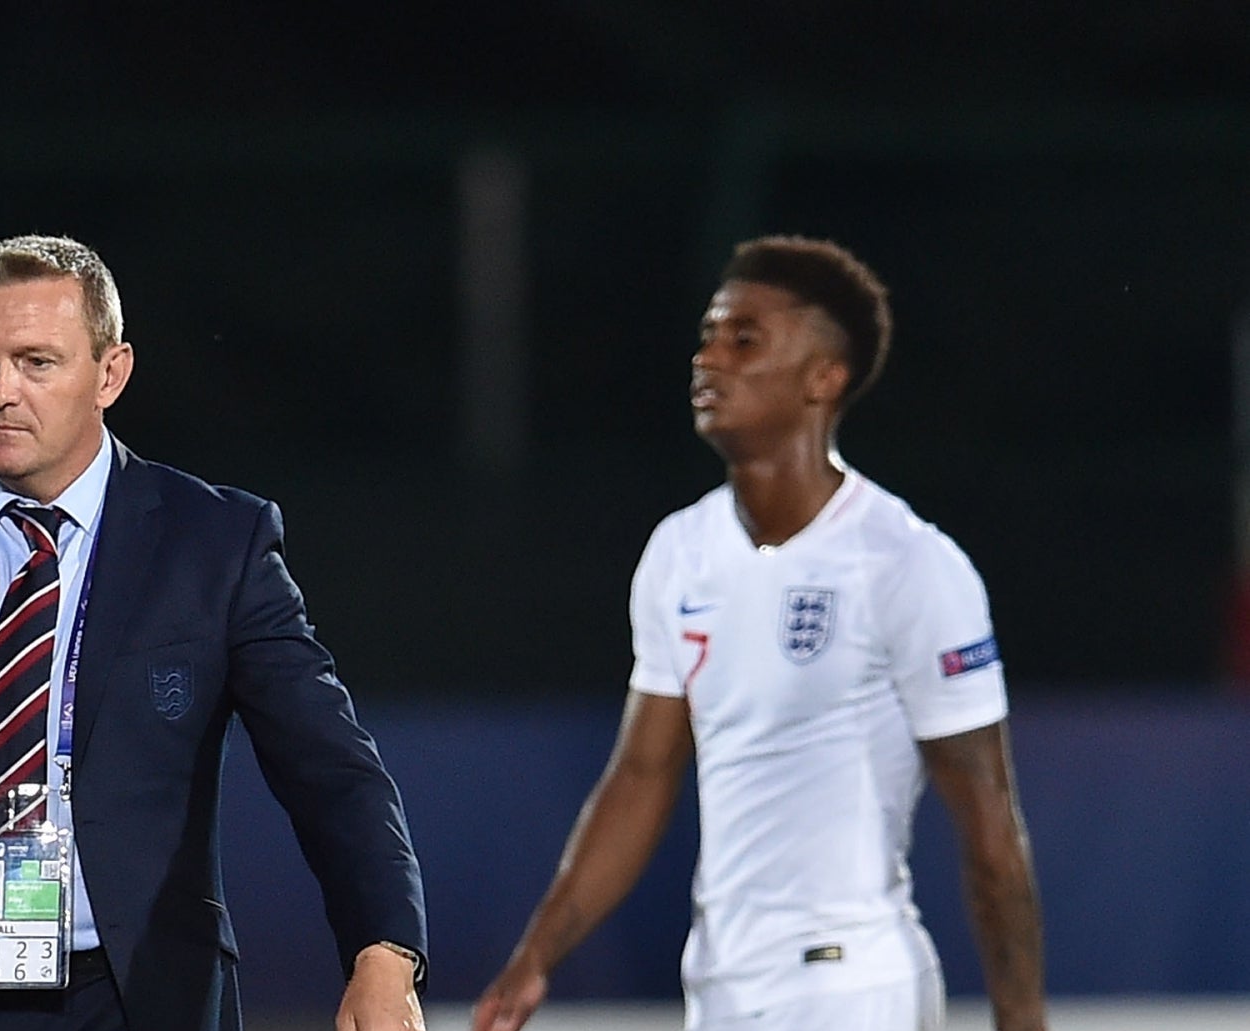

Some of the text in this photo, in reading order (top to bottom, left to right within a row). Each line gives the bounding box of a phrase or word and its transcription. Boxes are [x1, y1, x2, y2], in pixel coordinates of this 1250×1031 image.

[683, 631, 709, 698] 7
[16, 941, 28, 959] 2
[41, 941, 53, 959] 3
[14, 963, 26, 981] 6
